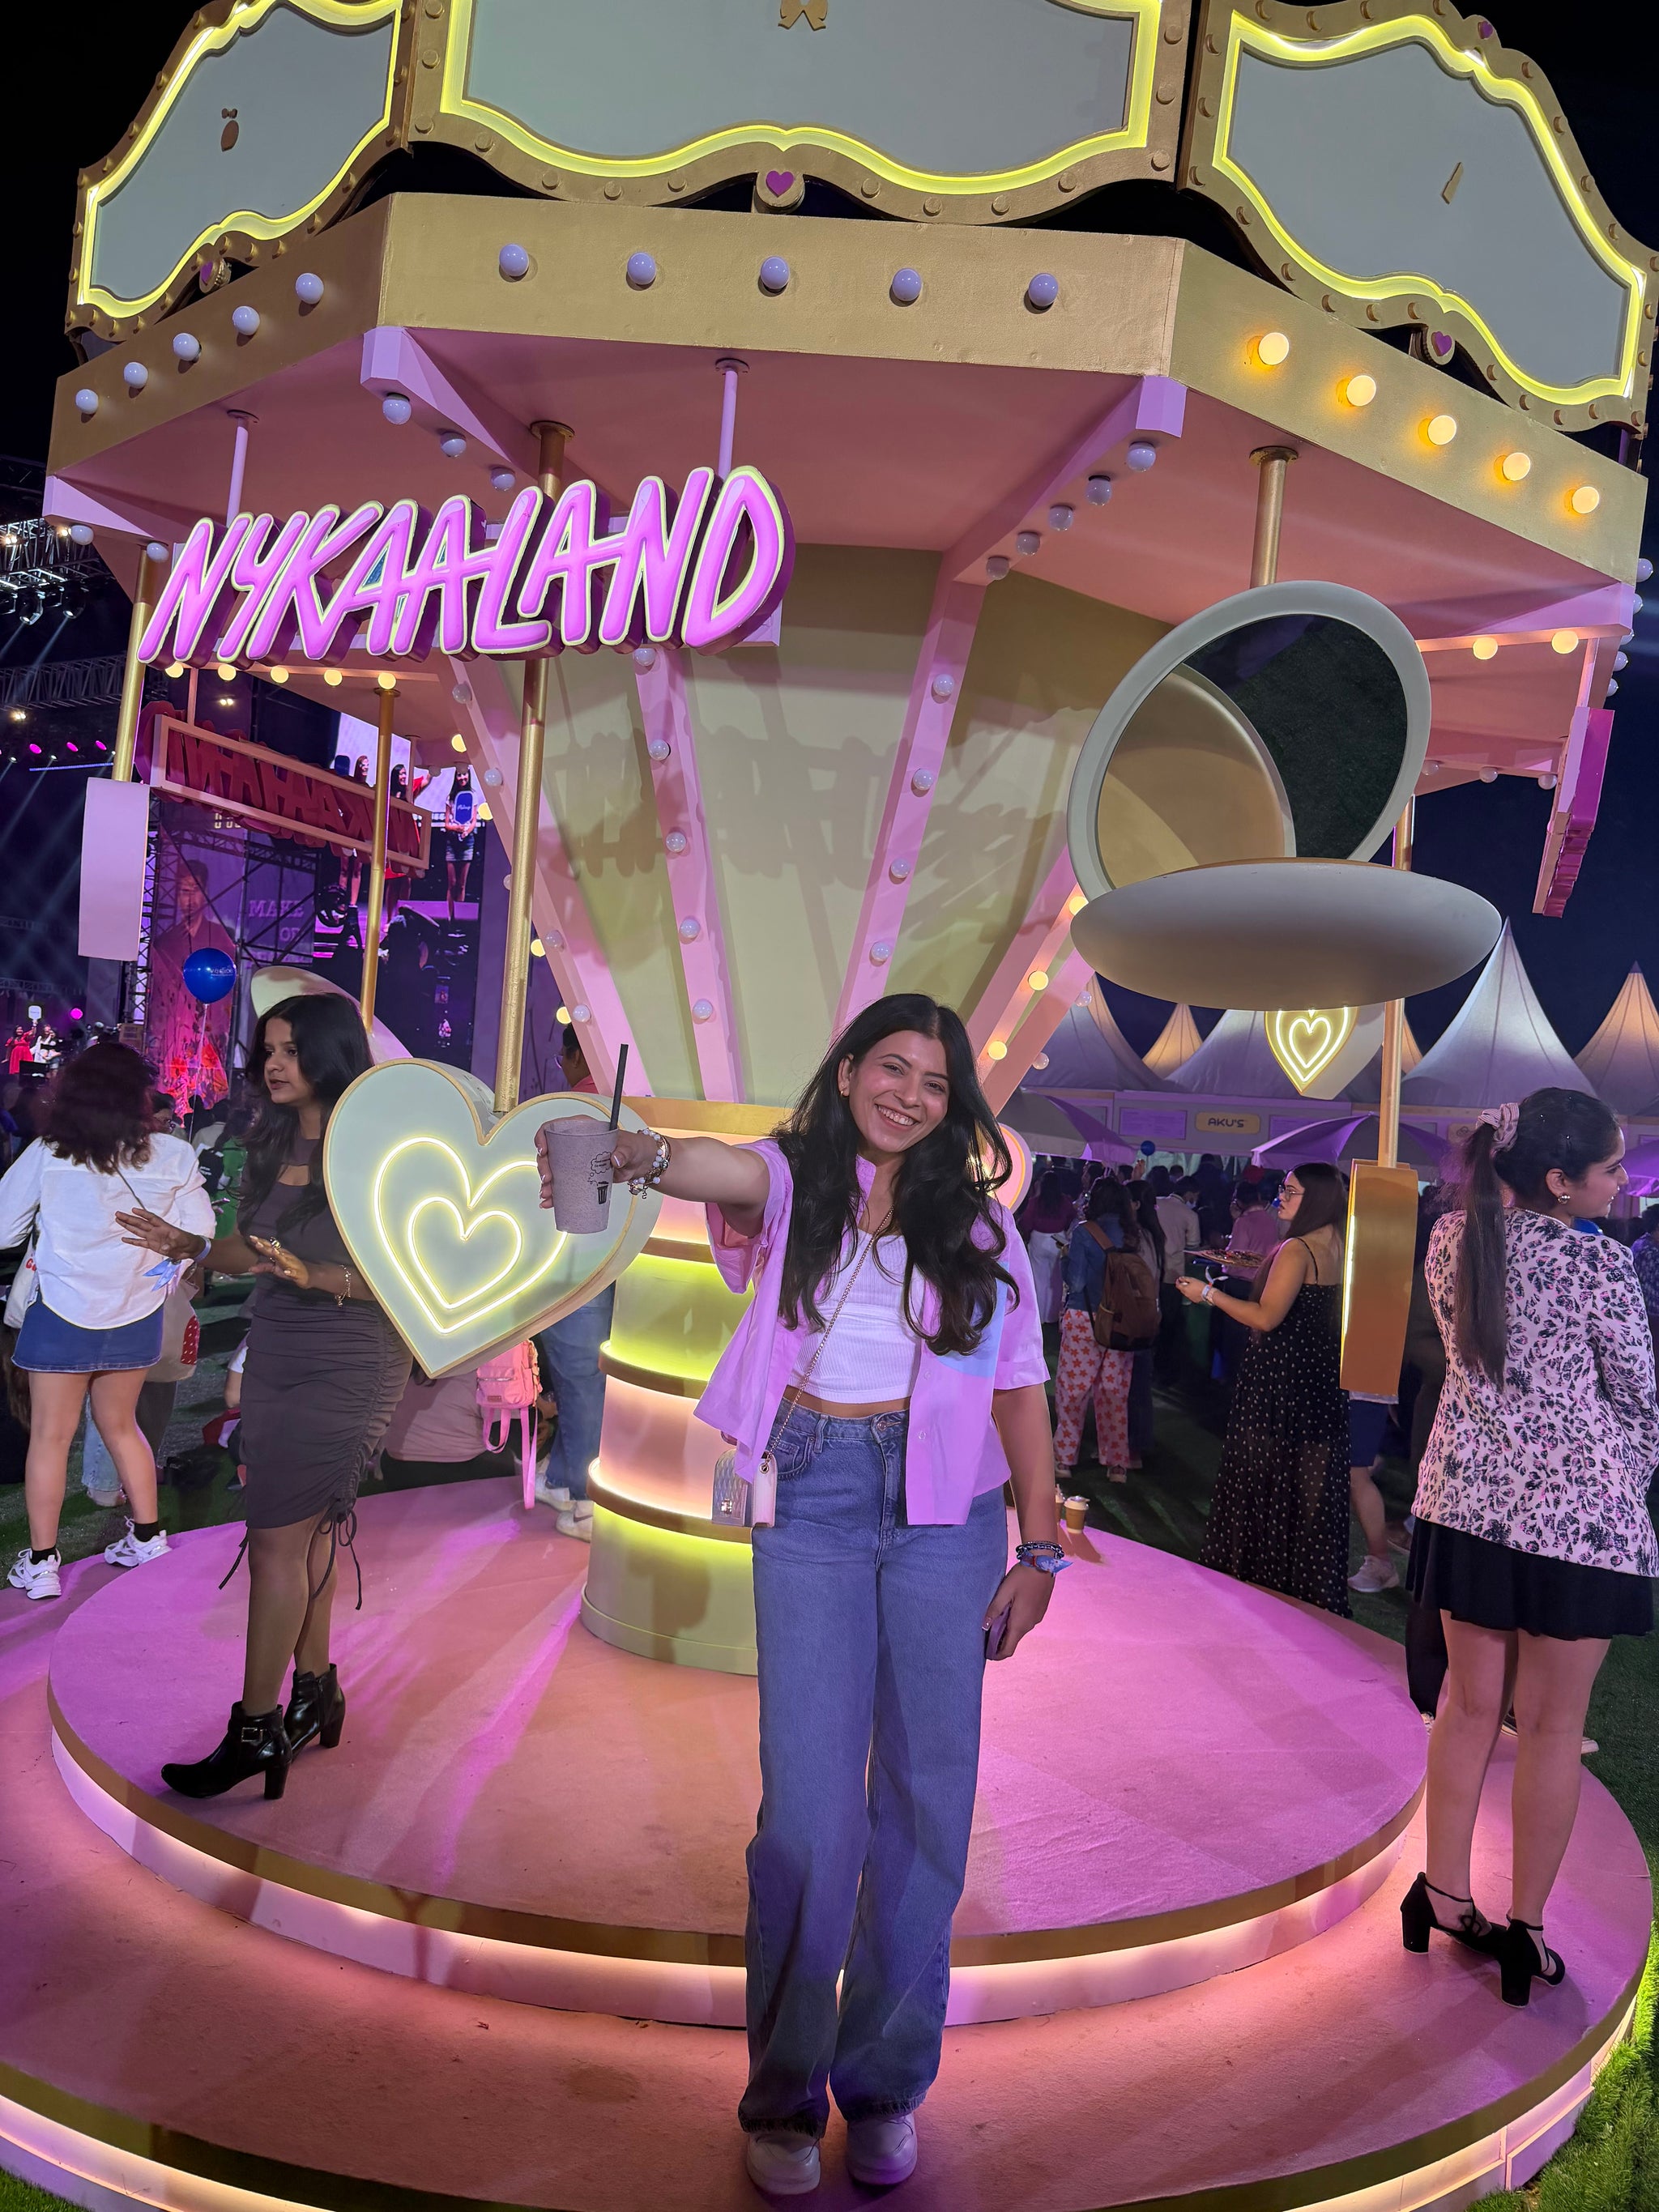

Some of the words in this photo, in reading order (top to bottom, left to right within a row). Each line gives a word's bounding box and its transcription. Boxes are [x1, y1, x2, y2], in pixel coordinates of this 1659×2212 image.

[137, 465, 786, 663] NYKAALAND
[249, 900, 305, 918] MAKE
[1208, 1118, 1245, 1128] AKU'S
